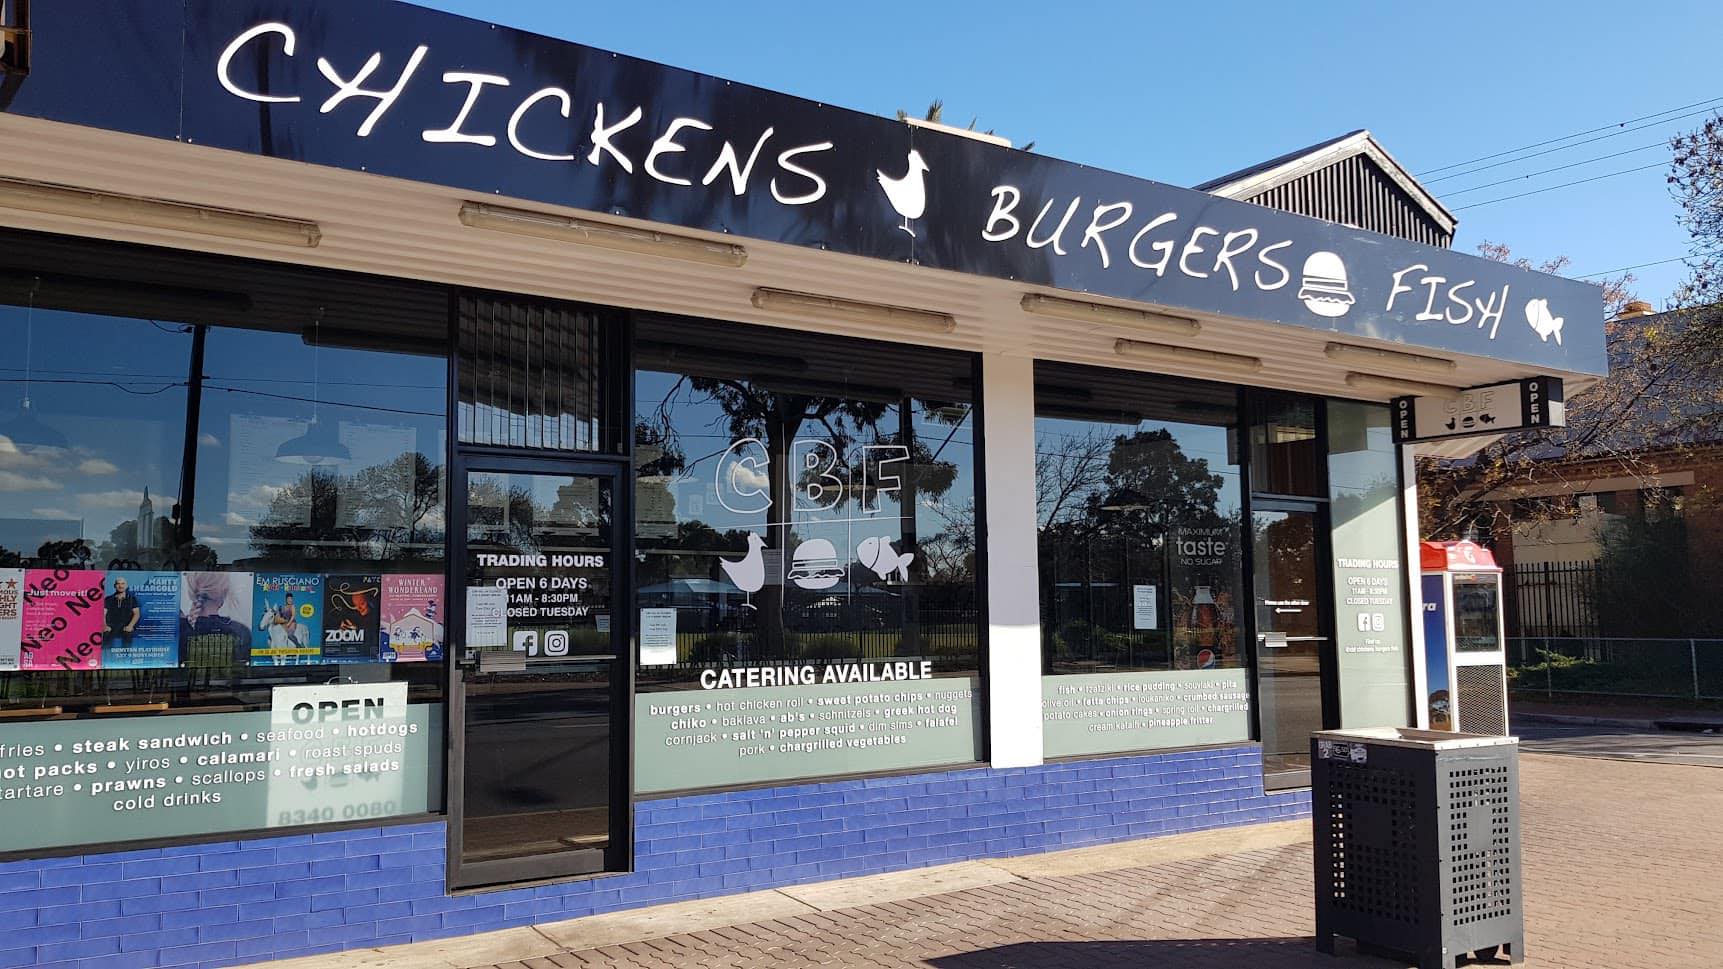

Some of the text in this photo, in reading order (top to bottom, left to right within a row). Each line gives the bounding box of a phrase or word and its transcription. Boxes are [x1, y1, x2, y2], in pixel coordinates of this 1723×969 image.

[217, 22, 833, 205] CHICKENS
[982, 185, 1293, 291] BURGERS
[1386, 264, 1510, 339] FISH
[1528, 382, 1540, 424] OPEN
[1399, 400, 1408, 438] OPEN
[715, 438, 910, 513] CBF
[1178, 528, 1222, 536] MAXIMUM
[1176, 537, 1226, 555] taste
[476, 554, 604, 567] TRADING HOURS
[1337, 558, 1399, 568] TRADING HOURS
[256, 577, 320, 586] EM RUSCIANO
[389, 586, 438, 594] WONDERLAND
[495, 577, 588, 589] OPEN 6 DAYS
[1347, 577, 1365, 585] OPEN
[541, 593, 578, 603] 8:30PM
[492, 607, 589, 617] CLOSED TUESDAY
[325, 629, 364, 642] ZOOM
[700, 661, 932, 690] CATERING AVAILABLE
[1058, 685, 1076, 694] fish
[1123, 683, 1140, 692] rice
[1142, 682, 1175, 692] pudding
[1222, 680, 1236, 690] pita
[650, 690, 972, 716] burgers hot chicken roll sweet potato chips nuggets
[1106, 696, 1128, 705] chips
[1184, 692, 1217, 702] crumbed
[291, 698, 384, 724] OPEN
[671, 703, 957, 730] chiko baklava ab's schnitzels greek hot dog
[1043, 710, 1071, 720] potato
[1105, 708, 1128, 717] onion
[1131, 706, 1153, 716] rings
[665, 732, 717, 746] cornjack
[732, 730, 756, 742] salt
[779, 726, 820, 740] pepper
[824, 722, 856, 736] squid
[868, 720, 886, 732] dim
[890, 719, 913, 730] sims
[925, 717, 958, 728] falafel
[1148, 718, 1188, 728] pineapple
[72, 738, 130, 754] steak
[138, 732, 232, 750] sandwich
[256, 728, 324, 742] seafood
[348, 724, 418, 737] hotdogs
[739, 734, 906, 758] pork chargrilled vegetables
[0, 740, 402, 780] ot packs yiros calamari roast spuds
[92, 776, 167, 796] prawns
[192, 769, 265, 784] scallops
[290, 763, 336, 778] fresh
[343, 758, 400, 774] salads
[113, 790, 222, 810] cold drinks
[279, 801, 396, 826] 8340 0080
